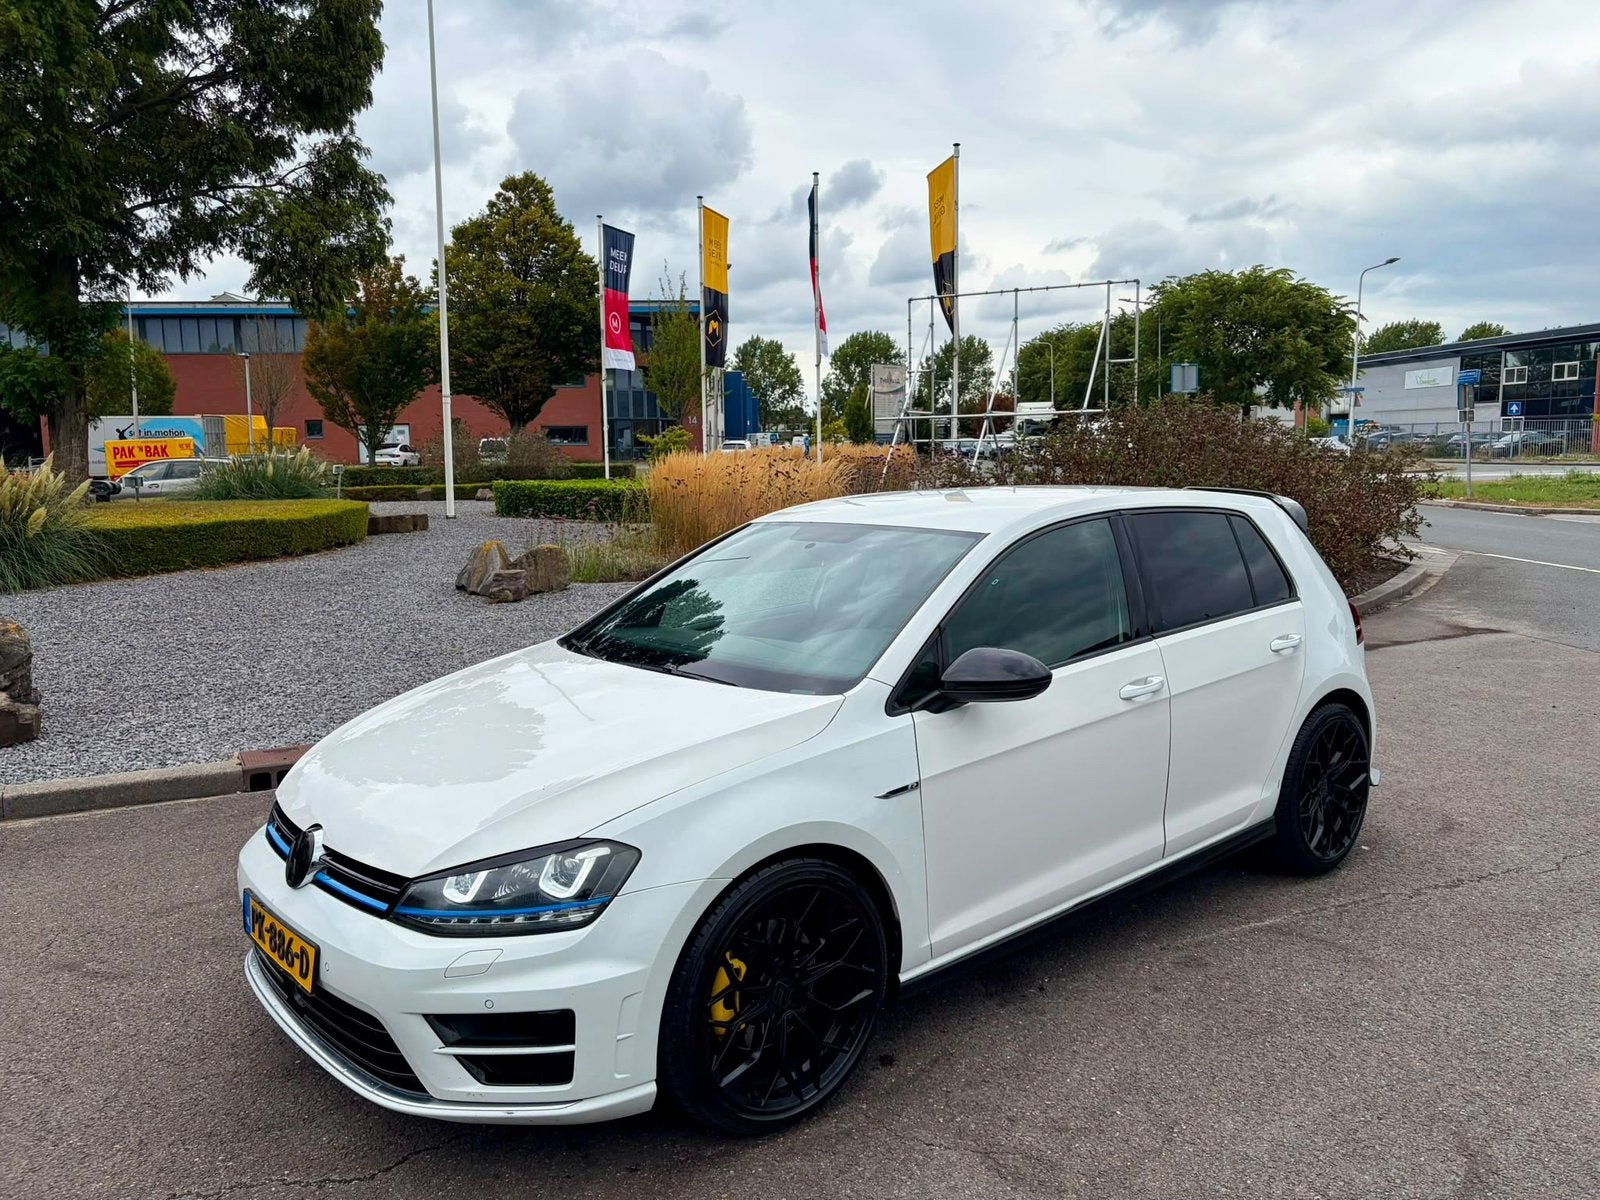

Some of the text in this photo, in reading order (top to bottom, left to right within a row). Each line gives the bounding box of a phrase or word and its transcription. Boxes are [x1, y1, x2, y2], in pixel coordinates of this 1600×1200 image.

[128, 428, 142, 437] st
[112, 445, 136, 460] PAK
[144, 444, 169, 458] BAK
